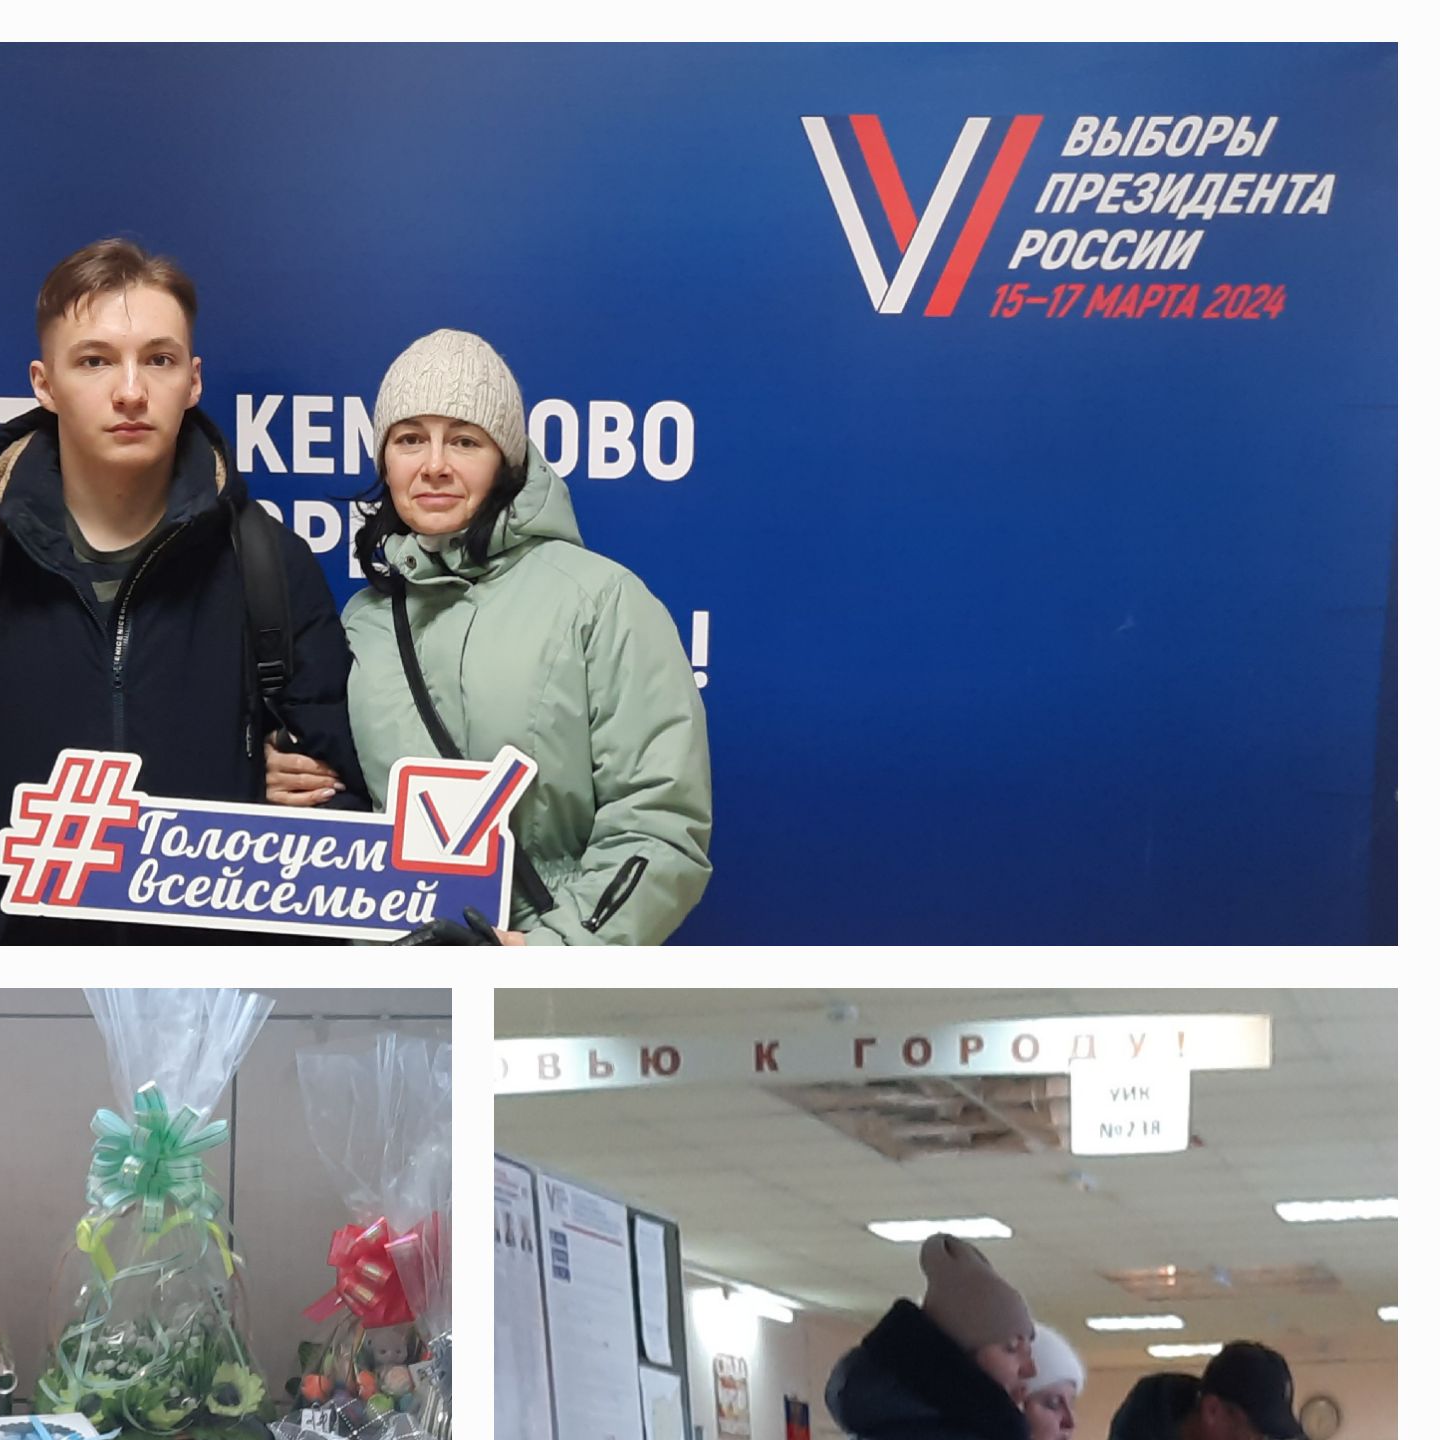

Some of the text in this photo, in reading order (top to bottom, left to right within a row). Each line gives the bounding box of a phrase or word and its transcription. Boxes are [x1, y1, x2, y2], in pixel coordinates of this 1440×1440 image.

[1061, 115, 1279, 157] ВЫБОРЫ
[1034, 172, 1337, 221] ПРЕЗИДЕНТА
[1008, 228, 1205, 270] РОССИИ
[1083, 284, 1195, 319] МАРТА
[1202, 284, 1288, 319] 2024
[136, 809, 387, 875] Голосуем
[127, 856, 439, 925] всейсемьей
[754, 1040, 779, 1073] К
[853, 1031, 1187, 1069] ГОРОДУ!
